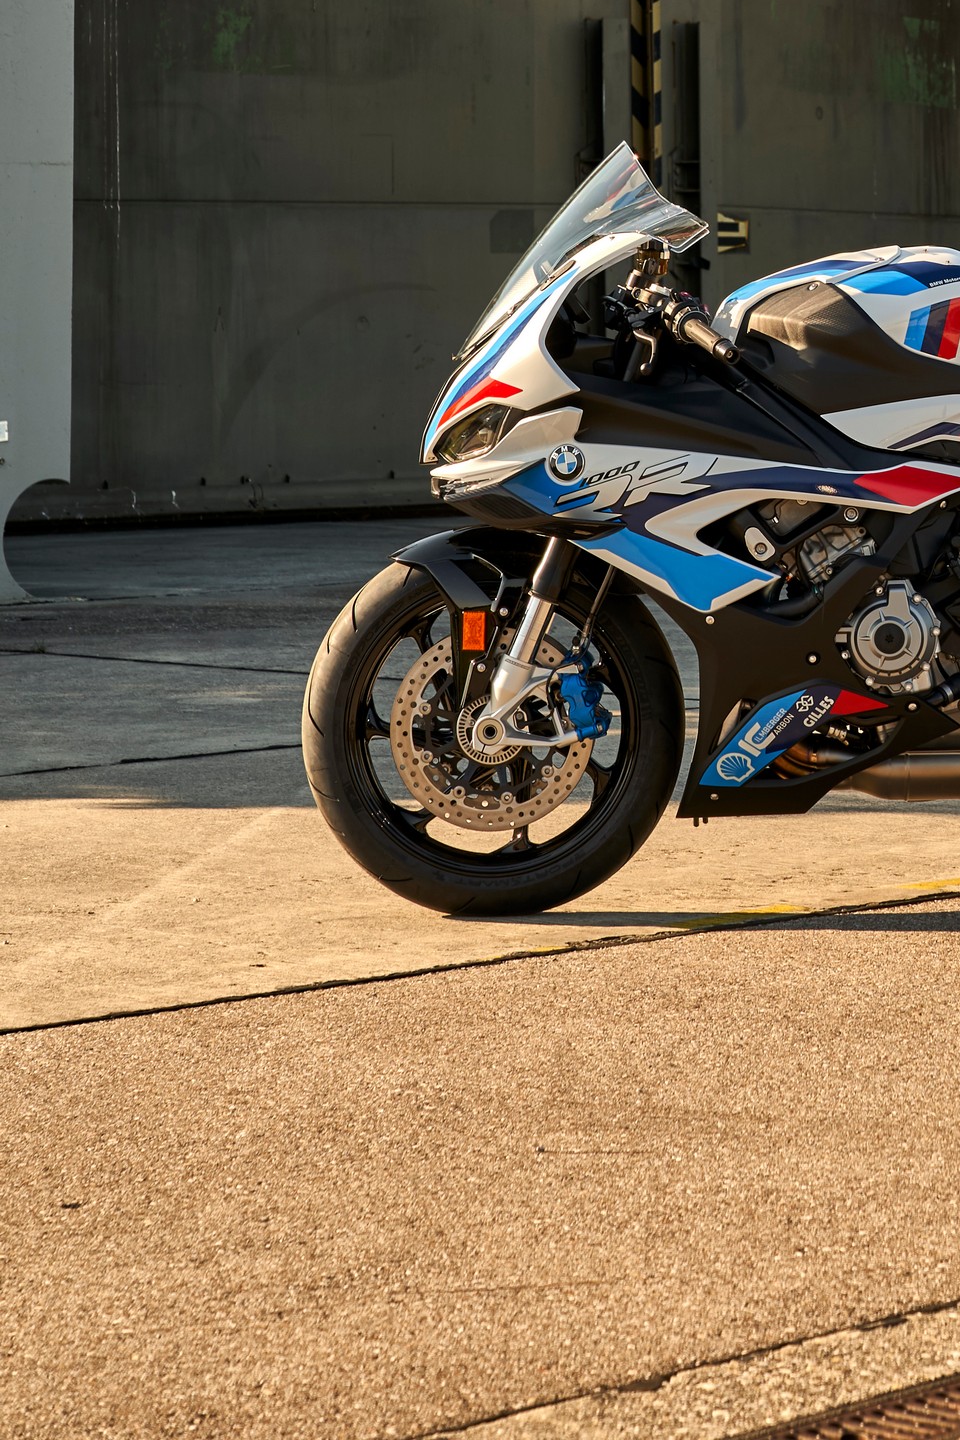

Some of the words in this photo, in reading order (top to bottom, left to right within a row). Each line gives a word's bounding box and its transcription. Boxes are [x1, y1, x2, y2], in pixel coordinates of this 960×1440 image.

[929, 279, 944, 288] BMW
[579, 461, 641, 488] 1000
[754, 707, 788, 743] ILMBERGER
[803, 695, 835, 728] GILLES
